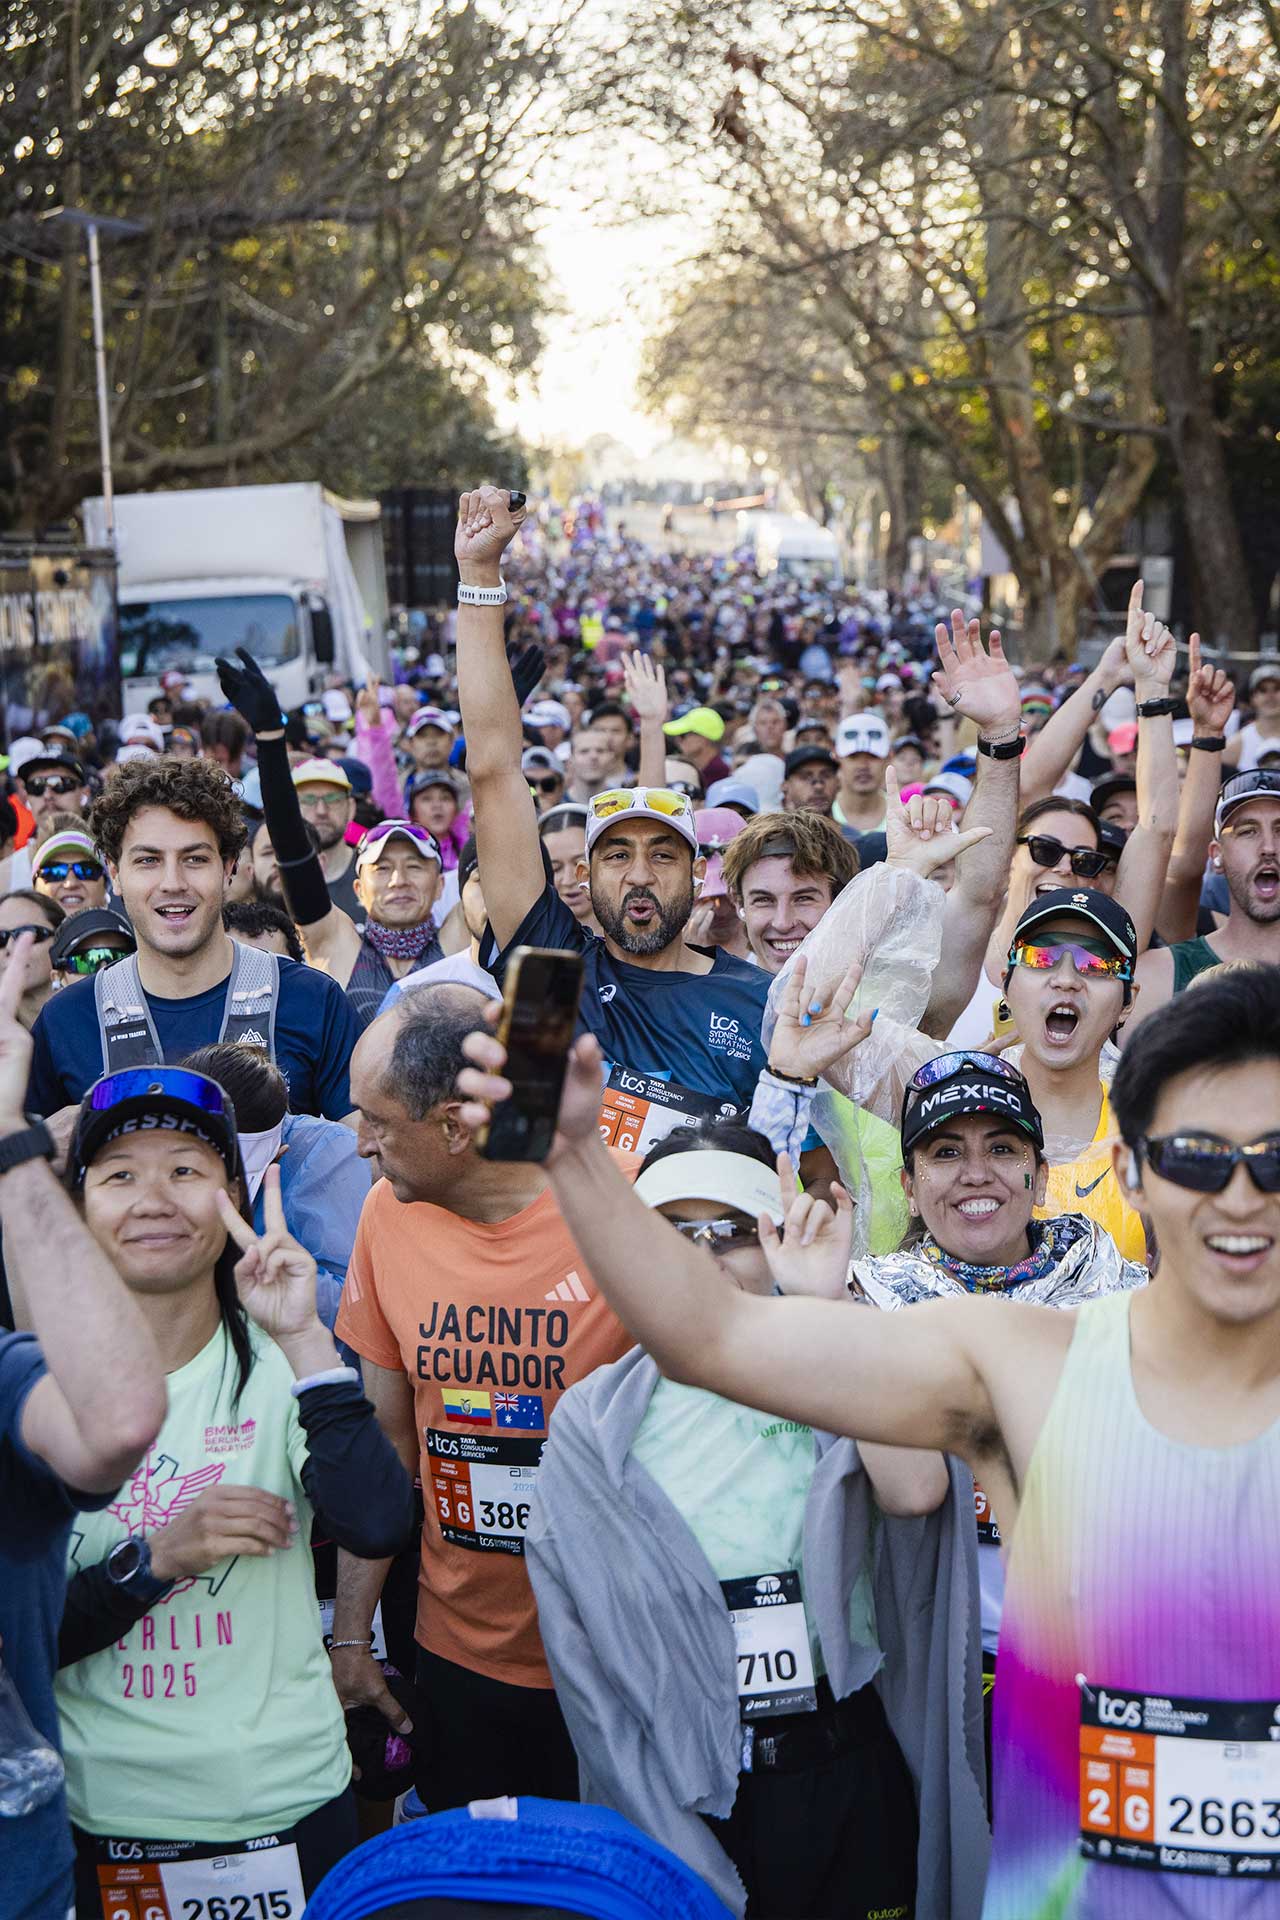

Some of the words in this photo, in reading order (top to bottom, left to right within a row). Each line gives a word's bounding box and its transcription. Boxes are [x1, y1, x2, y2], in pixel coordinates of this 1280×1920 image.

[710, 1011, 739, 1033] tcs
[709, 1030, 738, 1041] SYDNEY
[709, 1037, 752, 1054] MARATHON
[620, 1070, 646, 1094] tcs
[649, 1079, 665, 1089] TATA
[645, 1091, 670, 1103] SERVICES
[647, 1086, 685, 1102] CONSULTANCY
[921, 1083, 1021, 1118] MÉXICO
[618, 1132, 634, 1152] G
[419, 1302, 569, 1348] JACINTO
[417, 1345, 566, 1390] ECUADOR
[204, 1424, 239, 1437] BMW
[204, 1435, 240, 1446] BERLIN
[435, 1433, 459, 1456] tcs
[460, 1443, 499, 1454] CONSULTANCY
[461, 1450, 486, 1459] SERVICES
[439, 1496, 451, 1518] 3
[457, 1502, 471, 1523] G
[973, 1491, 987, 1514] G
[479, 1535, 495, 1548] tcs
[754, 1593, 788, 1606] TATA
[118, 1611, 233, 1651] RLIN
[737, 1649, 797, 1686] 710
[123, 1663, 197, 1699] 2025
[1098, 1690, 1142, 1728] tcs
[1088, 1787, 1111, 1827] 2
[1124, 1794, 1150, 1833] G
[1169, 1796, 1280, 1839] 2663
[108, 1838, 144, 1860] tcs
[246, 1835, 280, 1850] TATA
[182, 1889, 292, 1920] 26215
